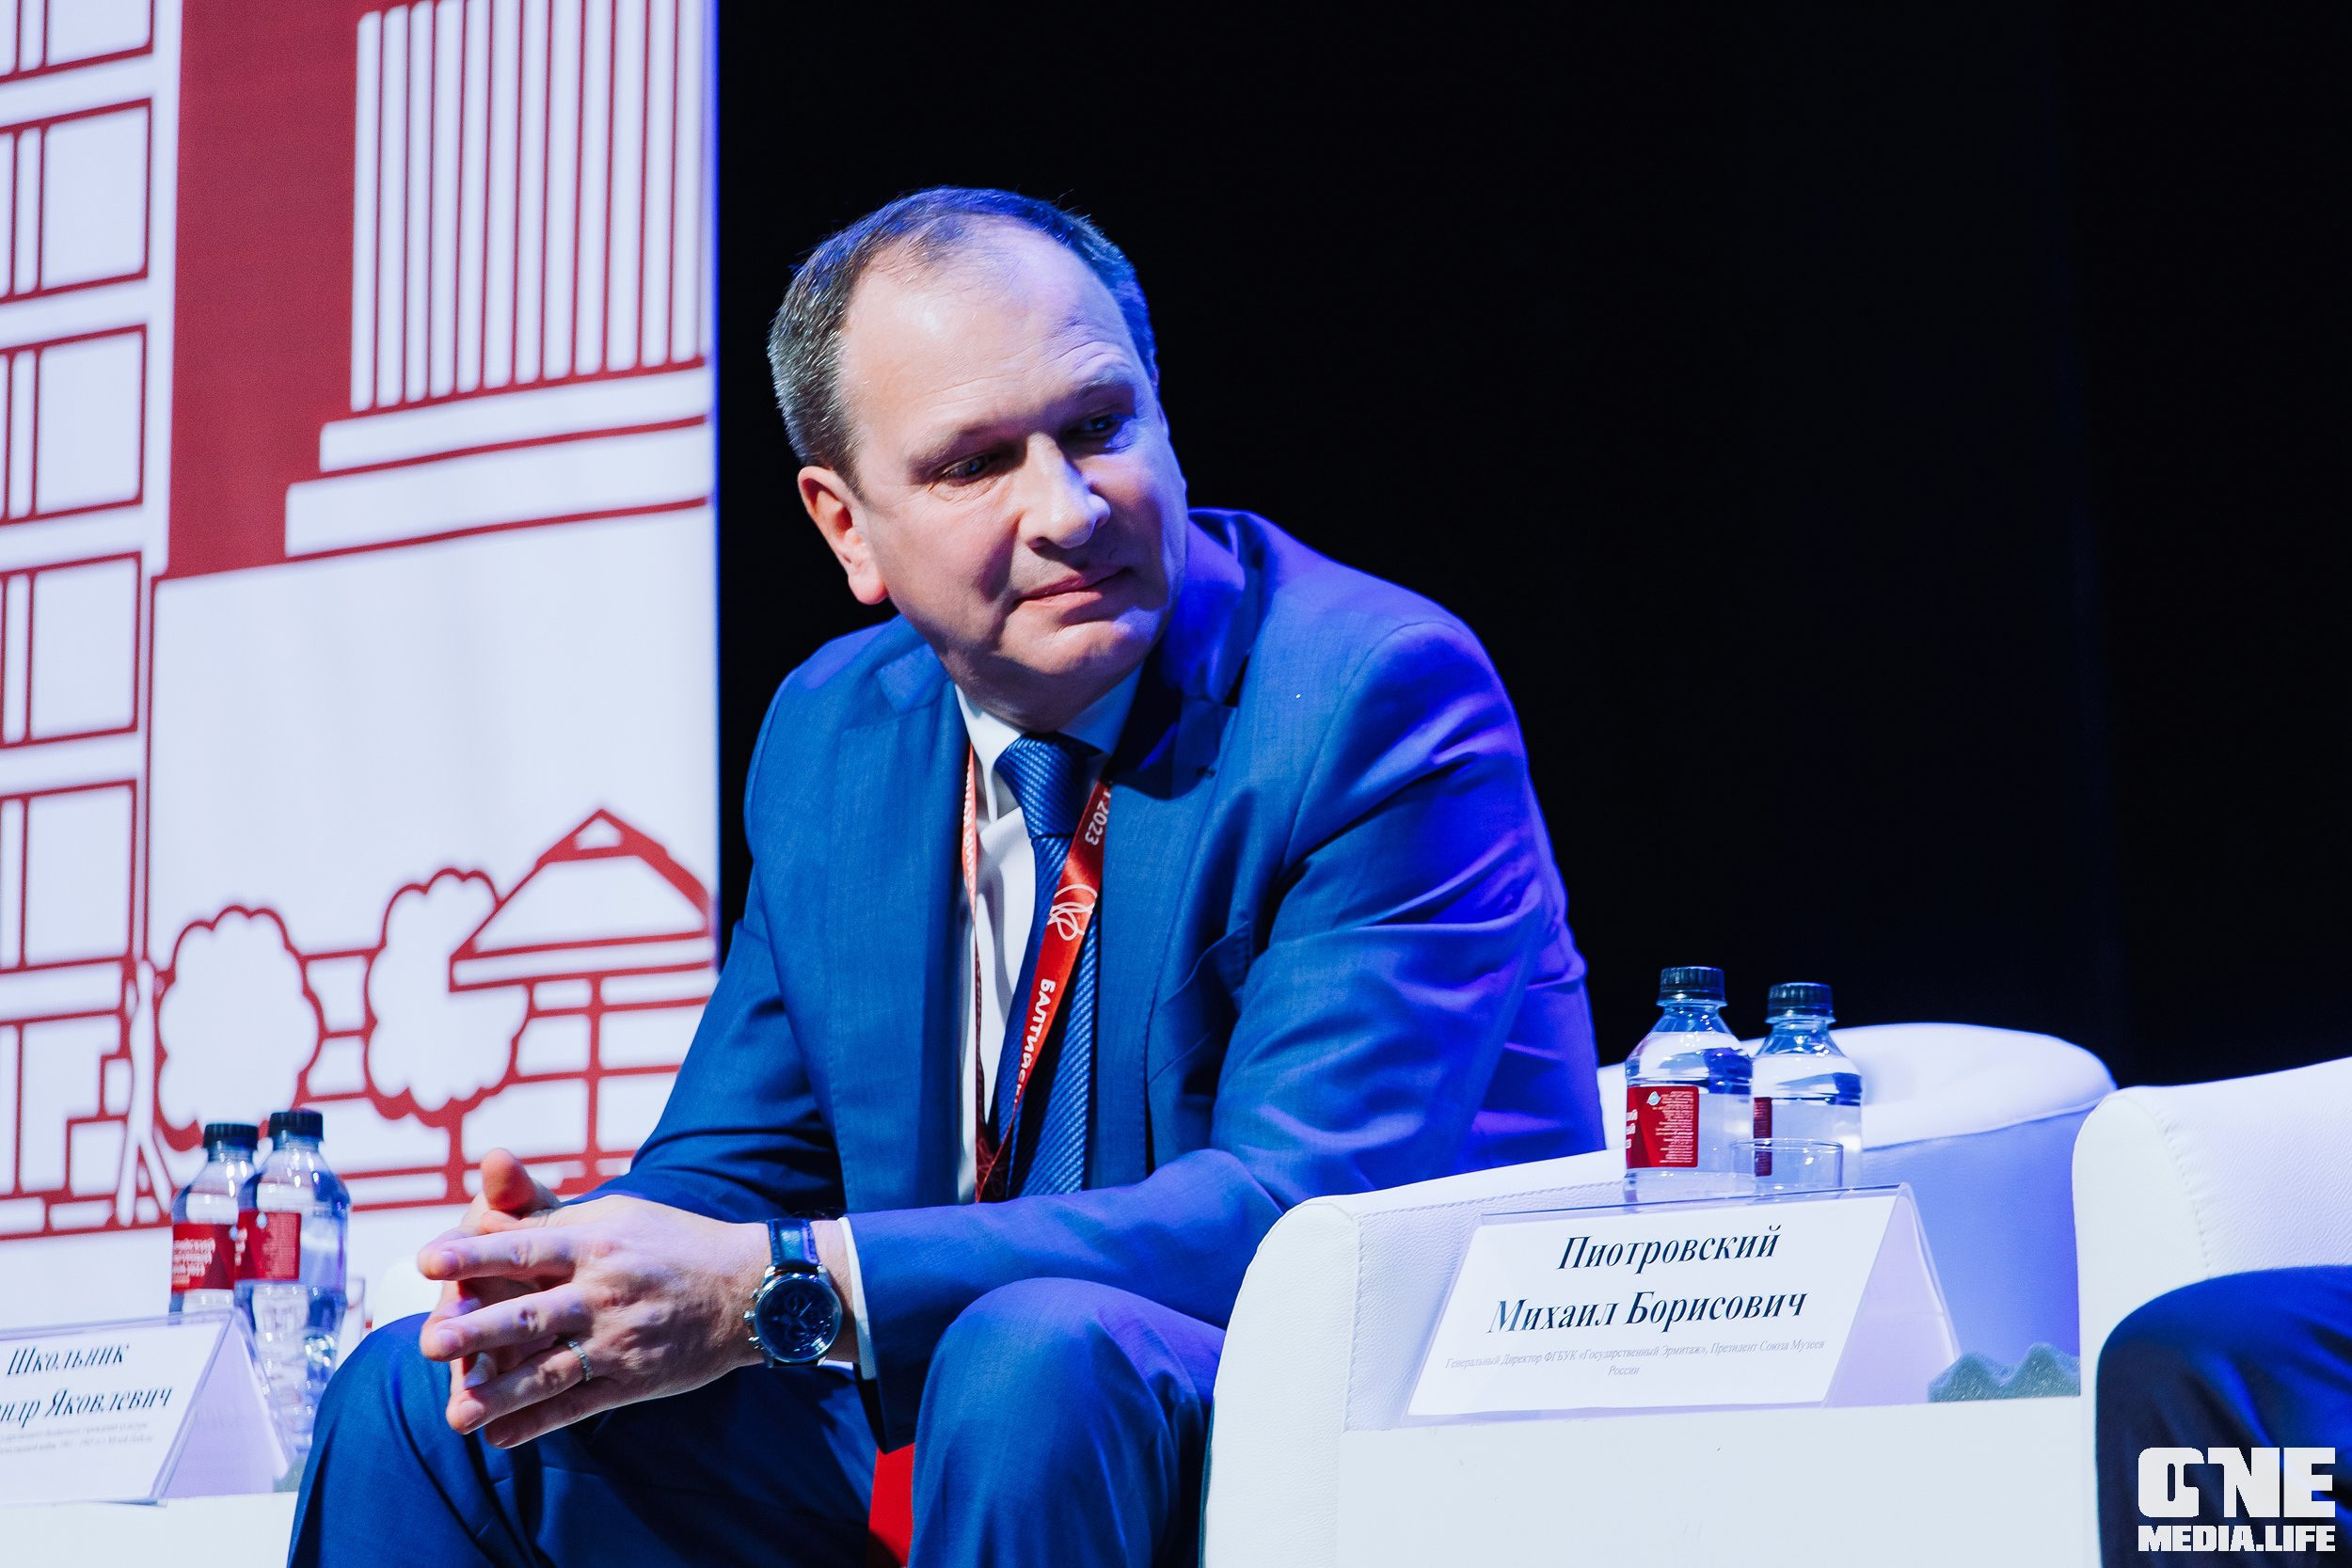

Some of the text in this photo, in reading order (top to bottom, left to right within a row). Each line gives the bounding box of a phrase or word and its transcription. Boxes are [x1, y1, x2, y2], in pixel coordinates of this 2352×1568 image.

[1084, 800, 1109, 846] 2023
[1556, 1225, 1782, 1275] Пиотровский
[1486, 1291, 1808, 1334] Михаил Борисович
[8, 1343, 130, 1376] Школьник
[1501, 1354, 1543, 1366] Директор
[1544, 1349, 1579, 1362] ФГБУК
[1710, 1341, 1757, 1355] Президент
[1759, 1339, 1789, 1352] Союза
[1790, 1338, 1825, 1353] Музеев
[1608, 1365, 1641, 1376] России
[0, 1386, 173, 1429] ндр Яковлевич
